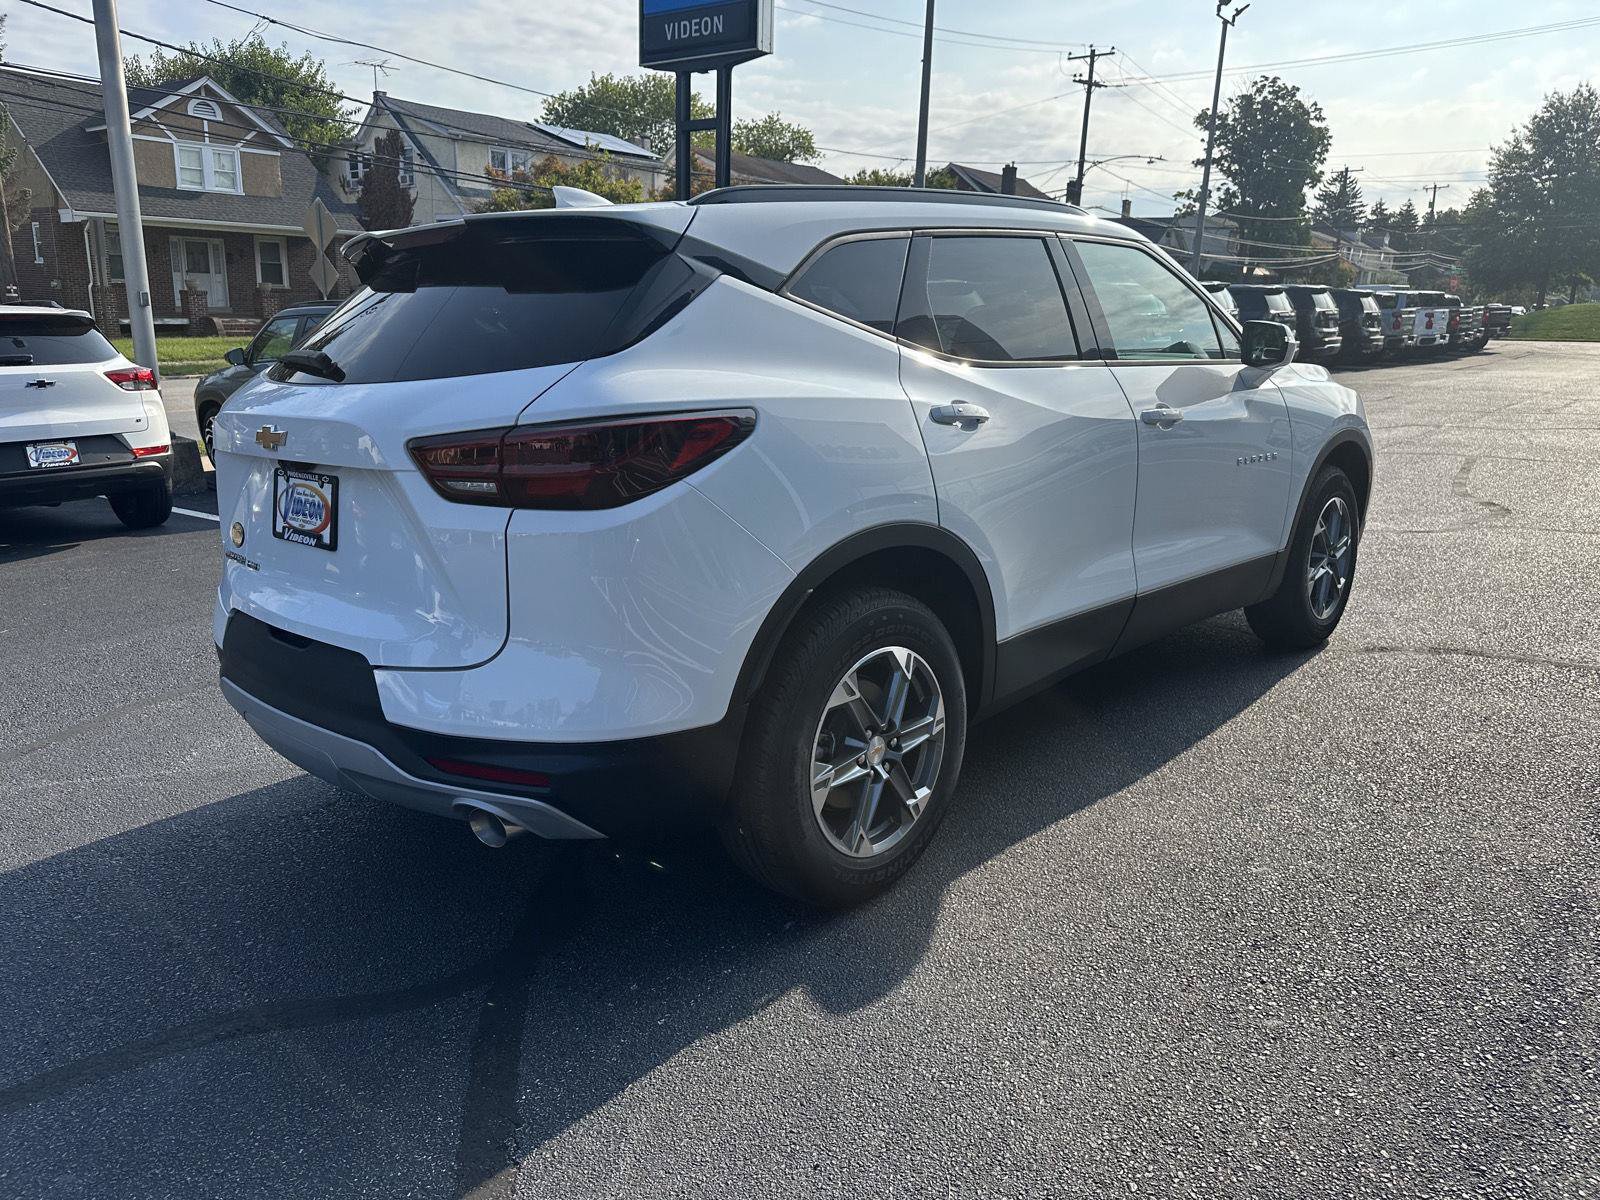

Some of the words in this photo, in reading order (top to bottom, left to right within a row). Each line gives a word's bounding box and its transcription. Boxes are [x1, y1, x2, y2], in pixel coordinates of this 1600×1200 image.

[665, 14, 723, 41] VIDEON
[34, 447, 69, 463] VIDEON
[1236, 452, 1278, 466] BLAZER
[287, 470, 319, 481] PHOENIXVILLE
[283, 483, 324, 522] VIDEON
[284, 527, 317, 547] VIDEON
